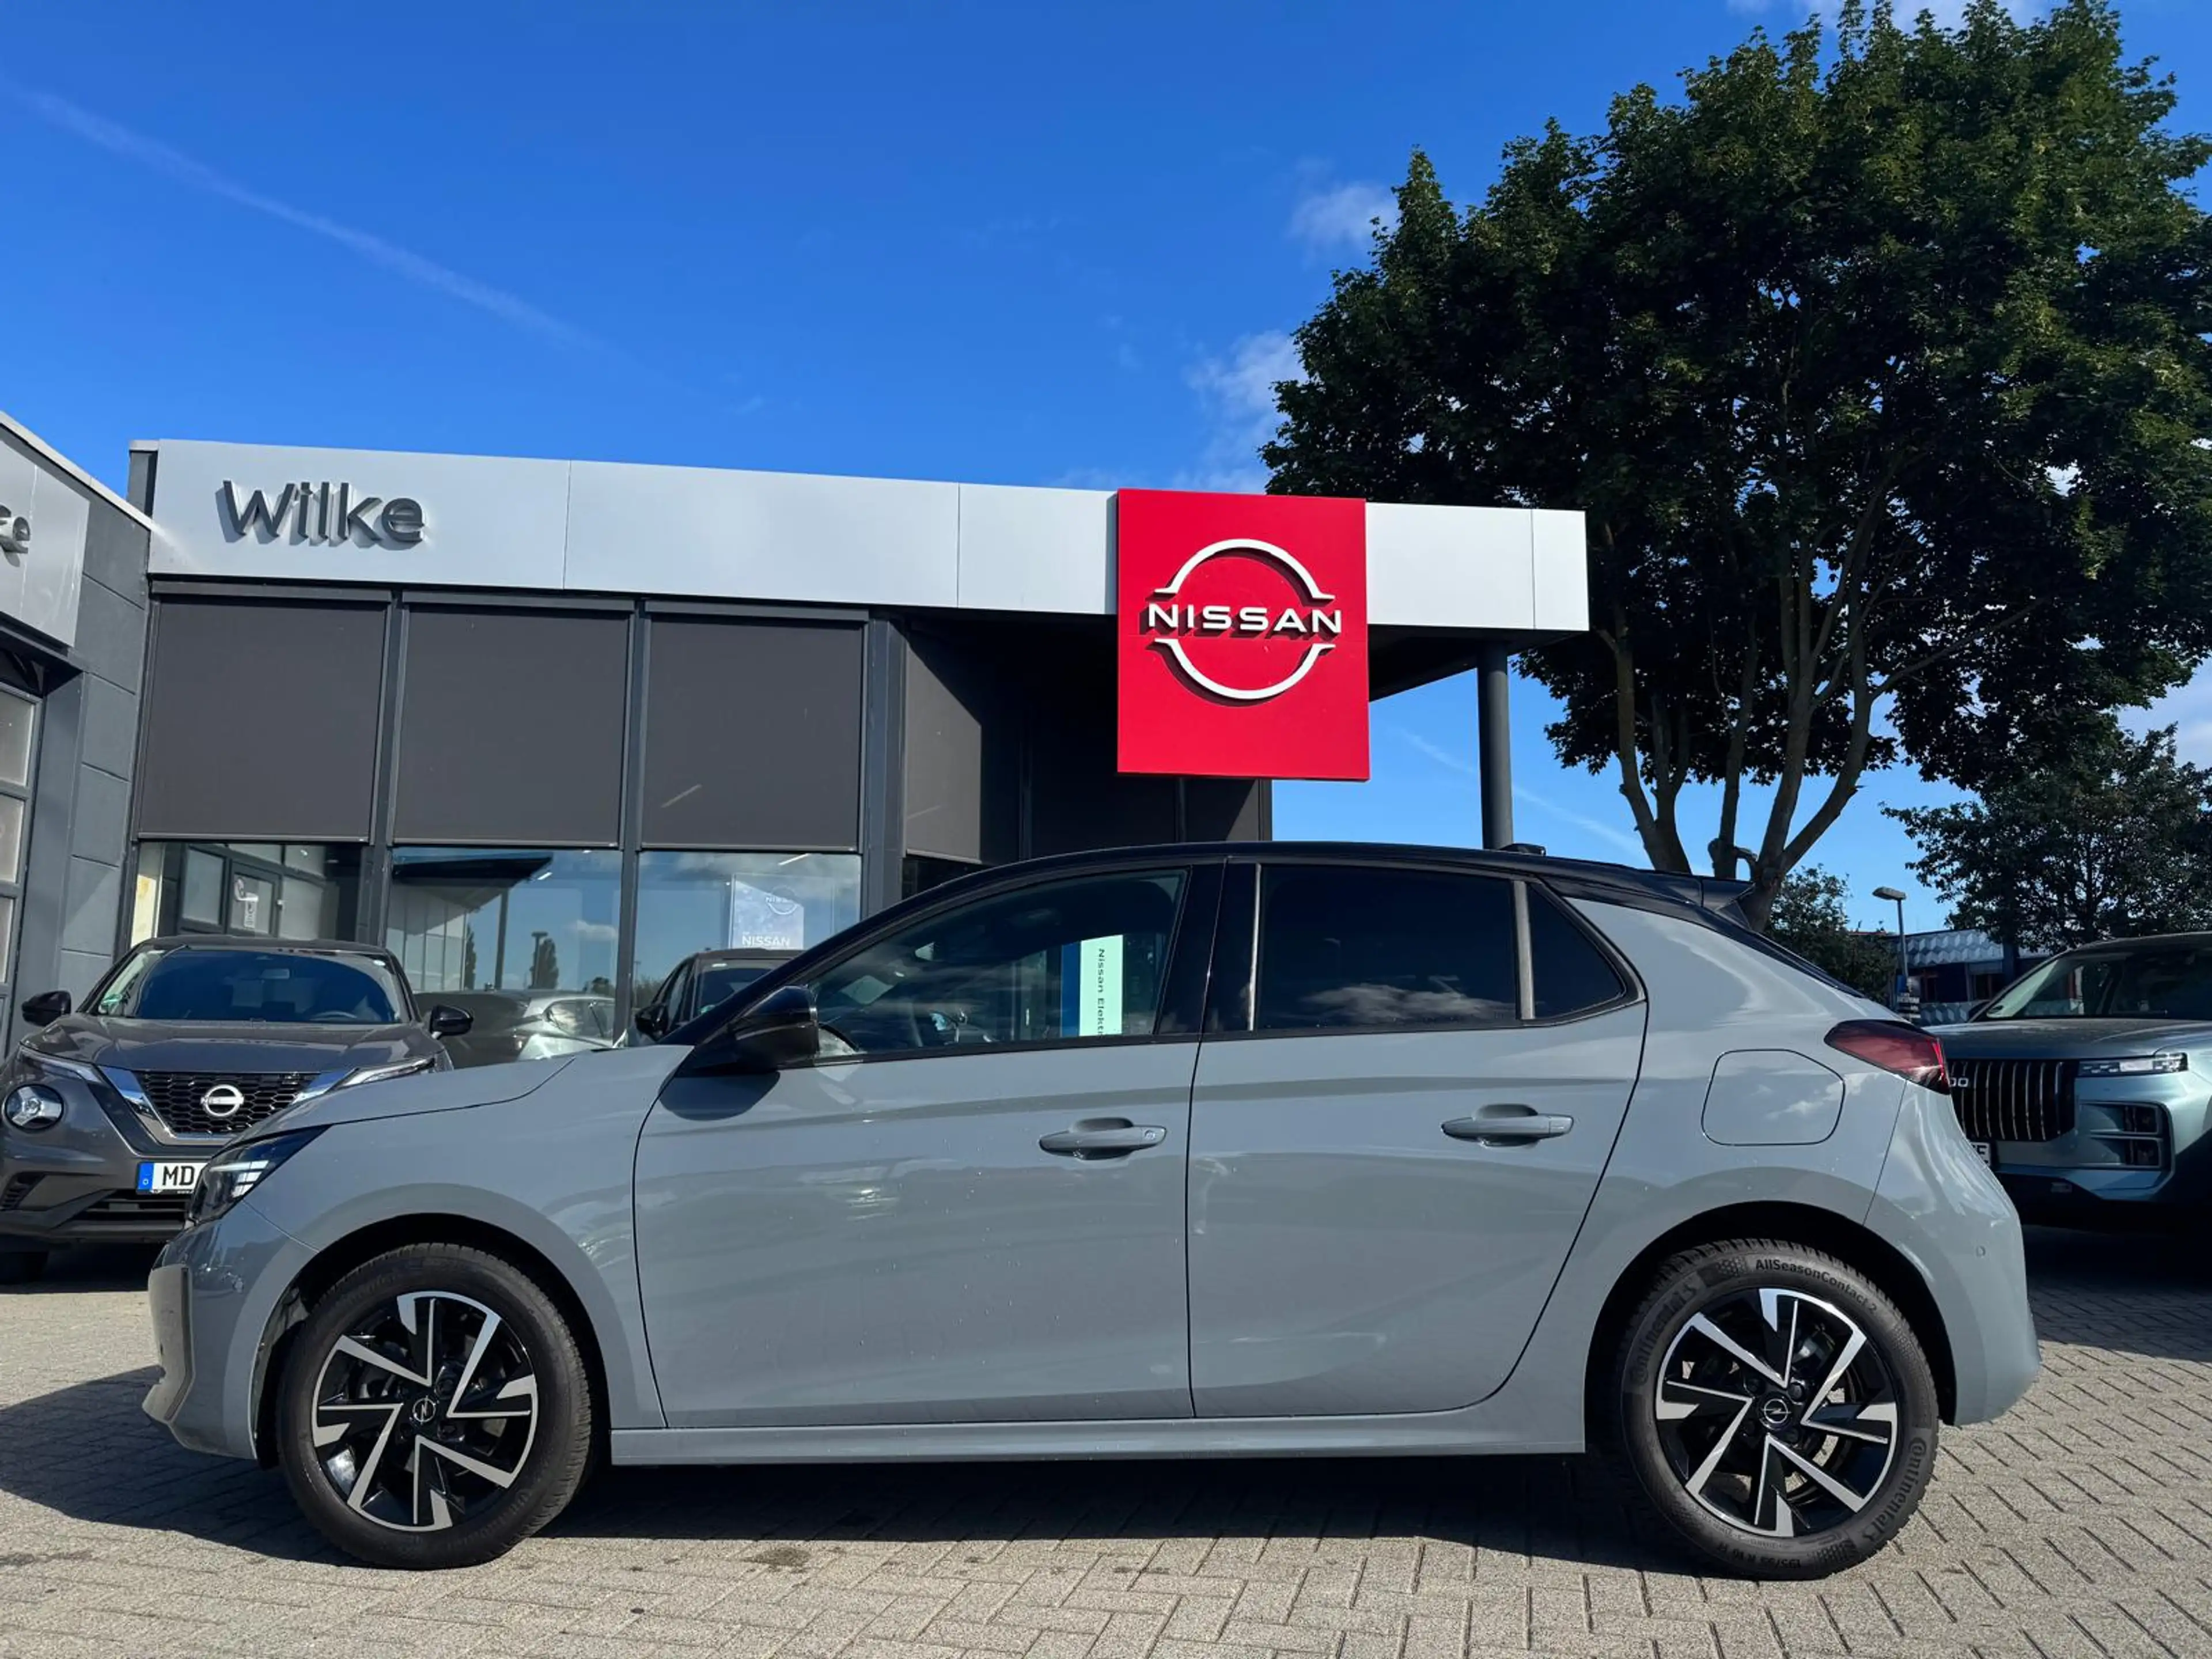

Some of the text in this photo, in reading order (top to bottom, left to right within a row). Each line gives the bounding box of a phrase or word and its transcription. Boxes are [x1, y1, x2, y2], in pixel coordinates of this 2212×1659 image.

[222, 480, 425, 543] Wilke
[1147, 602, 1342, 634] NISSAN
[741, 935, 790, 946] NISSAN
[1097, 948, 1105, 993] Nissan
[162, 1165, 195, 1186] MD
[1756, 1259, 1877, 1311] AllSeasonContact 2
[1872, 1436, 1927, 1534] Continental
